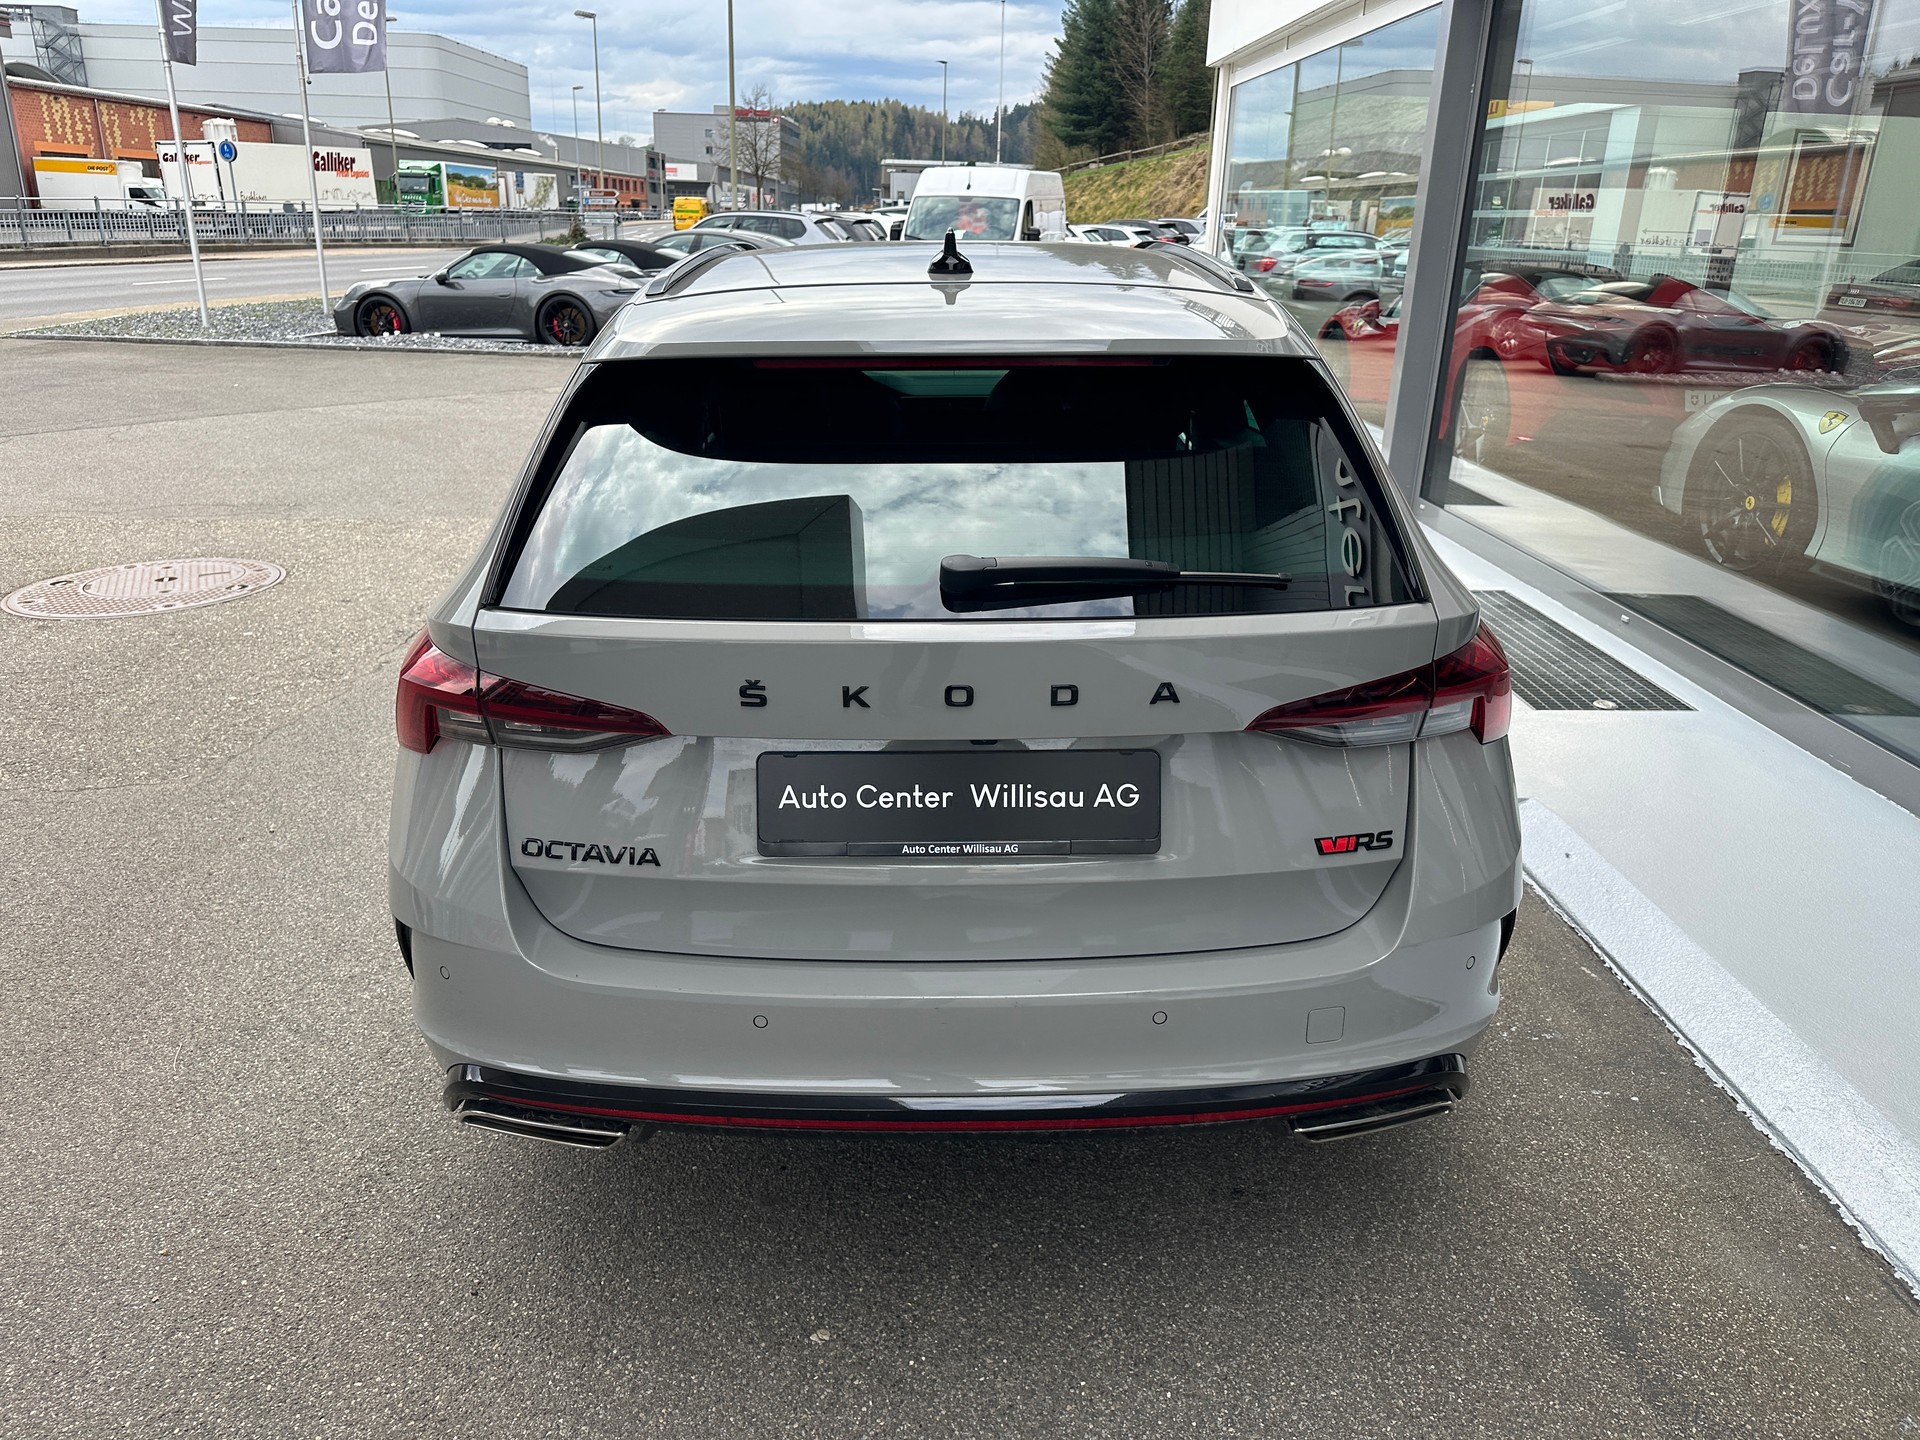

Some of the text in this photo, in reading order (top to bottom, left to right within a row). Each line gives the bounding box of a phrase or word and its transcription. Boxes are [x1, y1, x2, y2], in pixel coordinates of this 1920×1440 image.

[353, 0, 378, 45] De
[313, 151, 355, 171] Galliker
[778, 783, 1140, 809] Auto Center Willisau AG
[521, 838, 661, 867] OCTAVIA
[901, 844, 1019, 854] Auto Center Willisau AG
